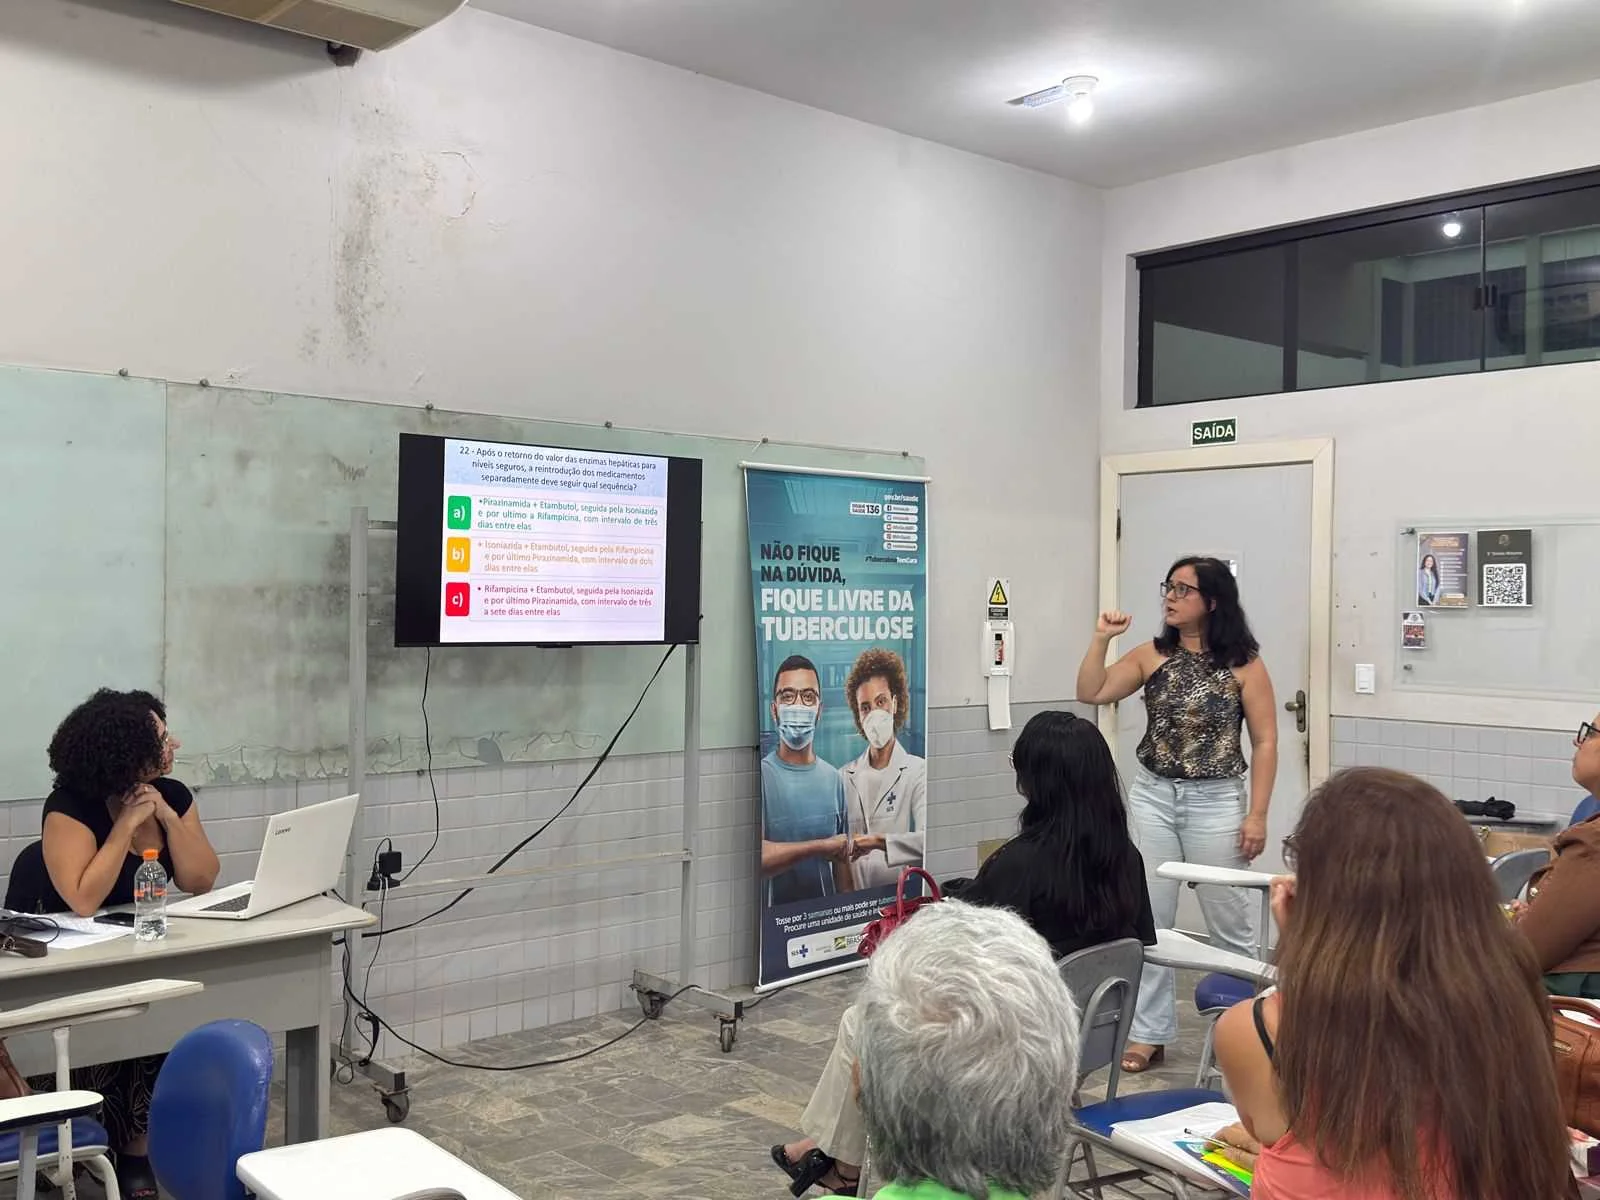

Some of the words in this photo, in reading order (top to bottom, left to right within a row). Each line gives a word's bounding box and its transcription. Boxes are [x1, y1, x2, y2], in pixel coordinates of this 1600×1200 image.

[1194, 422, 1234, 440] SAÍDA
[460, 446, 469, 454] 22
[476, 448, 495, 457] Após
[504, 451, 532, 460] retorno
[534, 452, 543, 460] do
[546, 454, 563, 462] valor
[579, 457, 607, 465] enzimas
[608, 458, 640, 469] hepáticas
[496, 463, 526, 472] seguros,
[535, 465, 580, 476] reintrodução
[596, 470, 646, 480] medicamentos
[481, 474, 539, 484] separadamente
[541, 477, 558, 485] deve
[560, 480, 581, 488] seguir
[453, 506, 466, 521] a)
[581, 504, 607, 513] seguida
[609, 506, 624, 514] pela
[866, 504, 880, 514] 136
[516, 522, 532, 530] elas
[601, 515, 631, 524] intervalo
[452, 546, 464, 564] b)
[491, 554, 505, 562] por
[760, 540, 793, 561] NÃO
[798, 544, 840, 563] FIQUE
[484, 563, 500, 571] dias
[523, 564, 538, 573] elas
[760, 566, 783, 582] NA
[787, 563, 846, 586] DÚVIDA,
[485, 585, 528, 593] Rifampicina
[577, 587, 603, 596] seguida
[605, 587, 619, 596] pela
[621, 587, 653, 596] Isoniazida
[452, 592, 463, 608] c)
[506, 596, 530, 604] último
[532, 597, 579, 605] Pirazinamida,
[761, 588, 823, 613] FIQUE
[827, 589, 884, 612] LIVRE
[889, 590, 914, 611] DA
[762, 616, 914, 641] TUBERCULOSE
[776, 917, 791, 925] Tosse
[792, 915, 802, 923] por
[842, 904, 854, 912] mais
[855, 901, 868, 910] pode
[784, 923, 806, 933] Procure
[808, 920, 820, 928] uma
[821, 915, 843, 926] unidade
